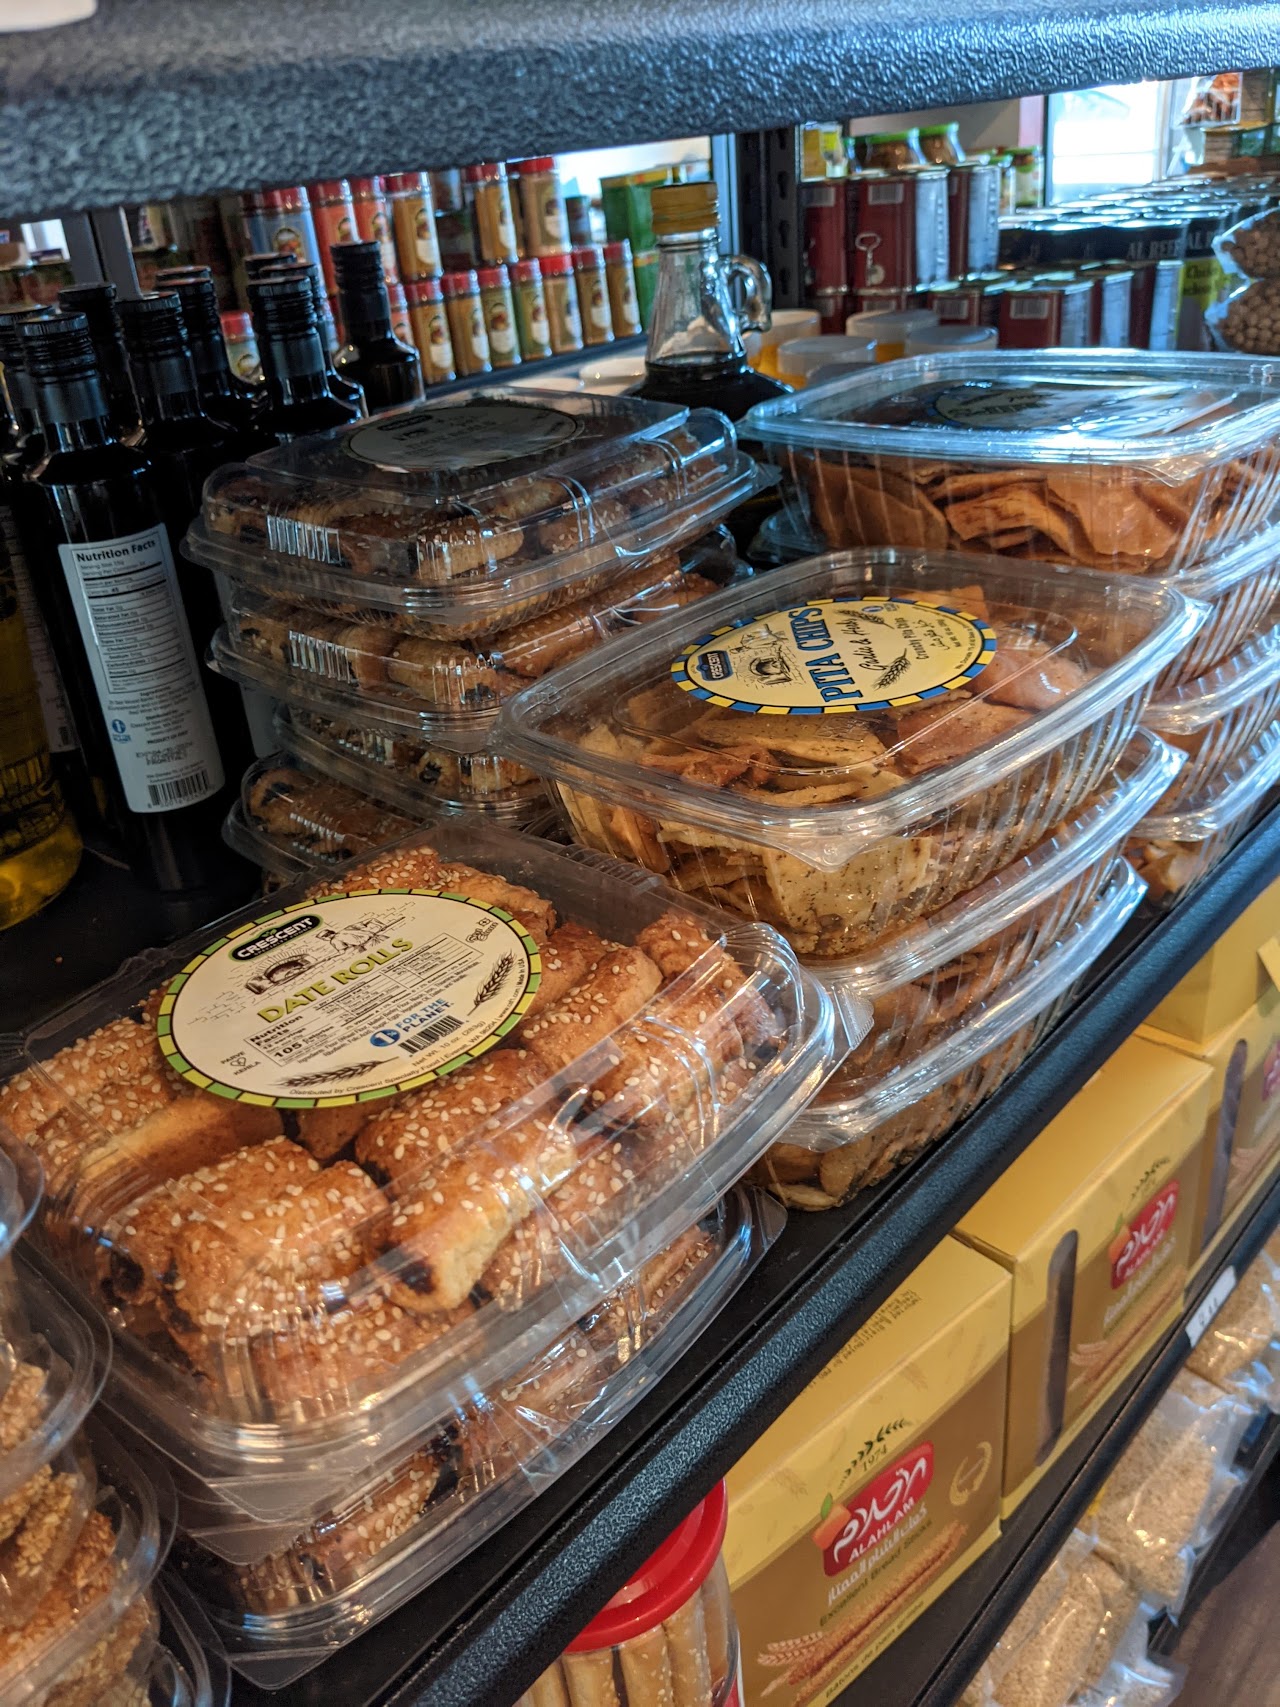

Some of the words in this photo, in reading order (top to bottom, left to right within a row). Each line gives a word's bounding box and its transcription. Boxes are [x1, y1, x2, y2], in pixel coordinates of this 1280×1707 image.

[76, 546, 130, 563] Nutrition
[131, 538, 157, 554] Facts
[788, 607, 834, 651] CHIPS
[853, 646, 889, 671] Garlic
[805, 652, 864, 703] PITA
[237, 916, 313, 958] CRESCENT
[257, 980, 336, 1023] DATE
[330, 937, 414, 985] ROLLS
[395, 1012, 419, 1028] FOR
[421, 998, 446, 1012] THE
[250, 1015, 303, 1042] Nutrition
[255, 1028, 290, 1046] Facts
[274, 1027, 307, 1045] servings
[302, 1025, 335, 1042] Calories
[220, 1051, 246, 1064] PARVE
[273, 1041, 303, 1058] 105
[412, 1058, 427, 1067] Net
[440, 1041, 451, 1052] 10
[233, 1060, 261, 1076] KEHILA
[289, 1087, 333, 1096] Distributed
[346, 1080, 383, 1092] Crescent
[384, 1068, 420, 1084] Specialty
[420, 1058, 440, 1072] Food
[470, 1034, 482, 1044] WA
[849, 1496, 915, 1563] ALAHLAM
